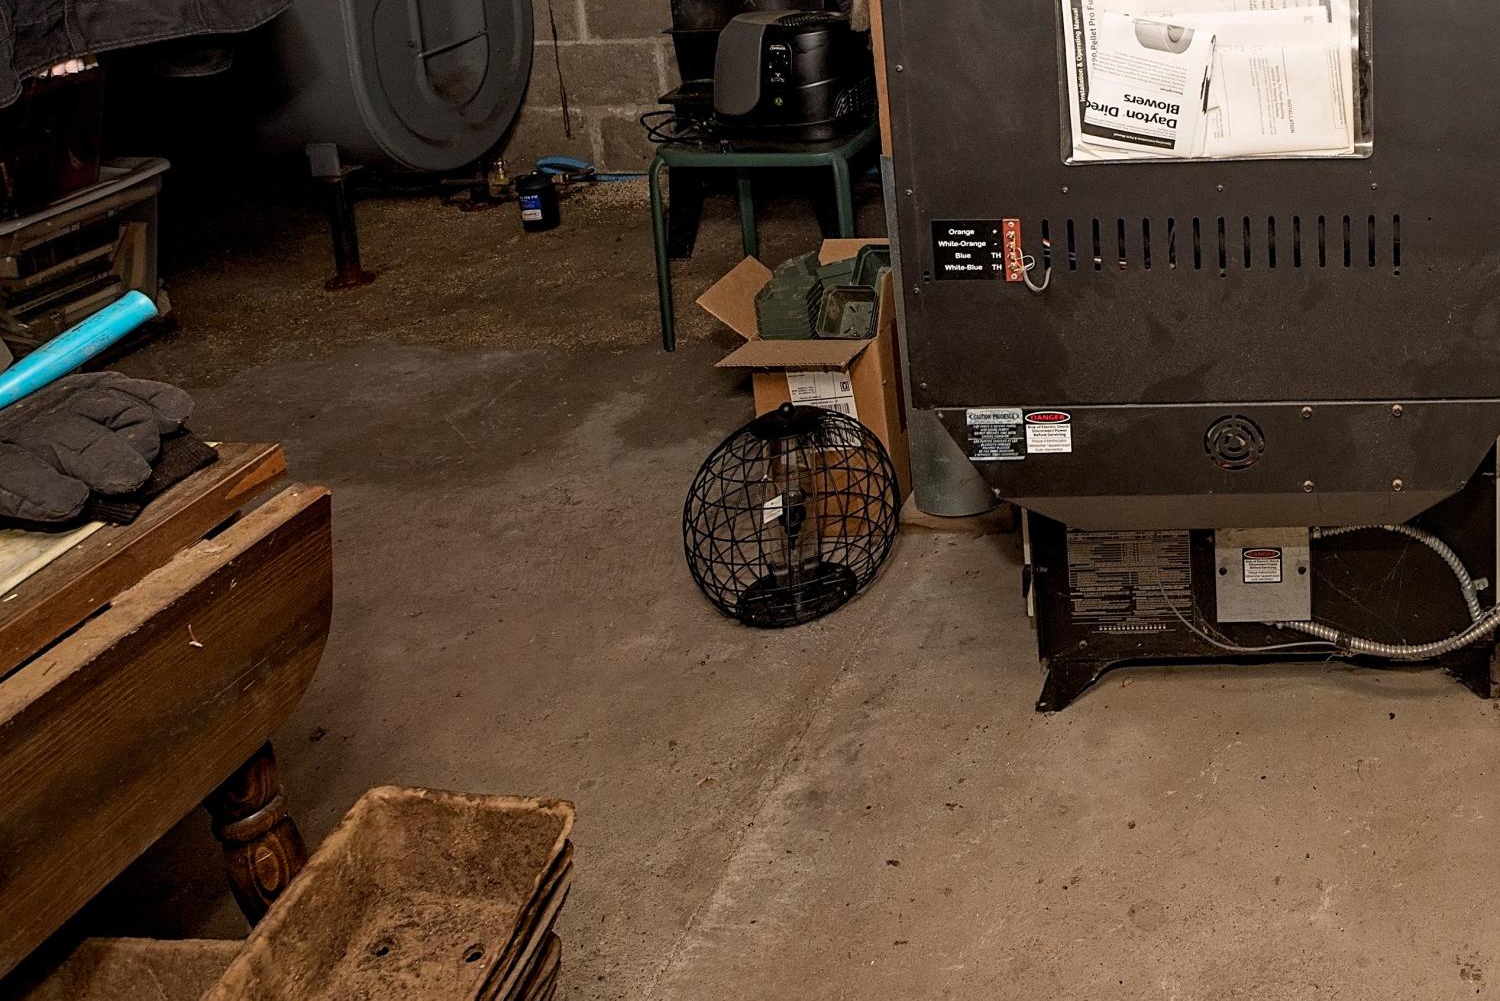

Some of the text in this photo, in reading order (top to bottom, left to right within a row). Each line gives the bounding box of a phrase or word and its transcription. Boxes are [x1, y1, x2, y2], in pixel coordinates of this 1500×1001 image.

[1071, 8, 1080, 30] Manual
[1075, 31, 1083, 61] Operating
[1078, 69, 1086, 102] Installation
[1124, 94, 1180, 115] Blowers
[1127, 110, 1178, 129] Dayton
[948, 228, 975, 236] Orange
[938, 240, 987, 248] White-Orange
[991, 263, 1003, 271] TH
